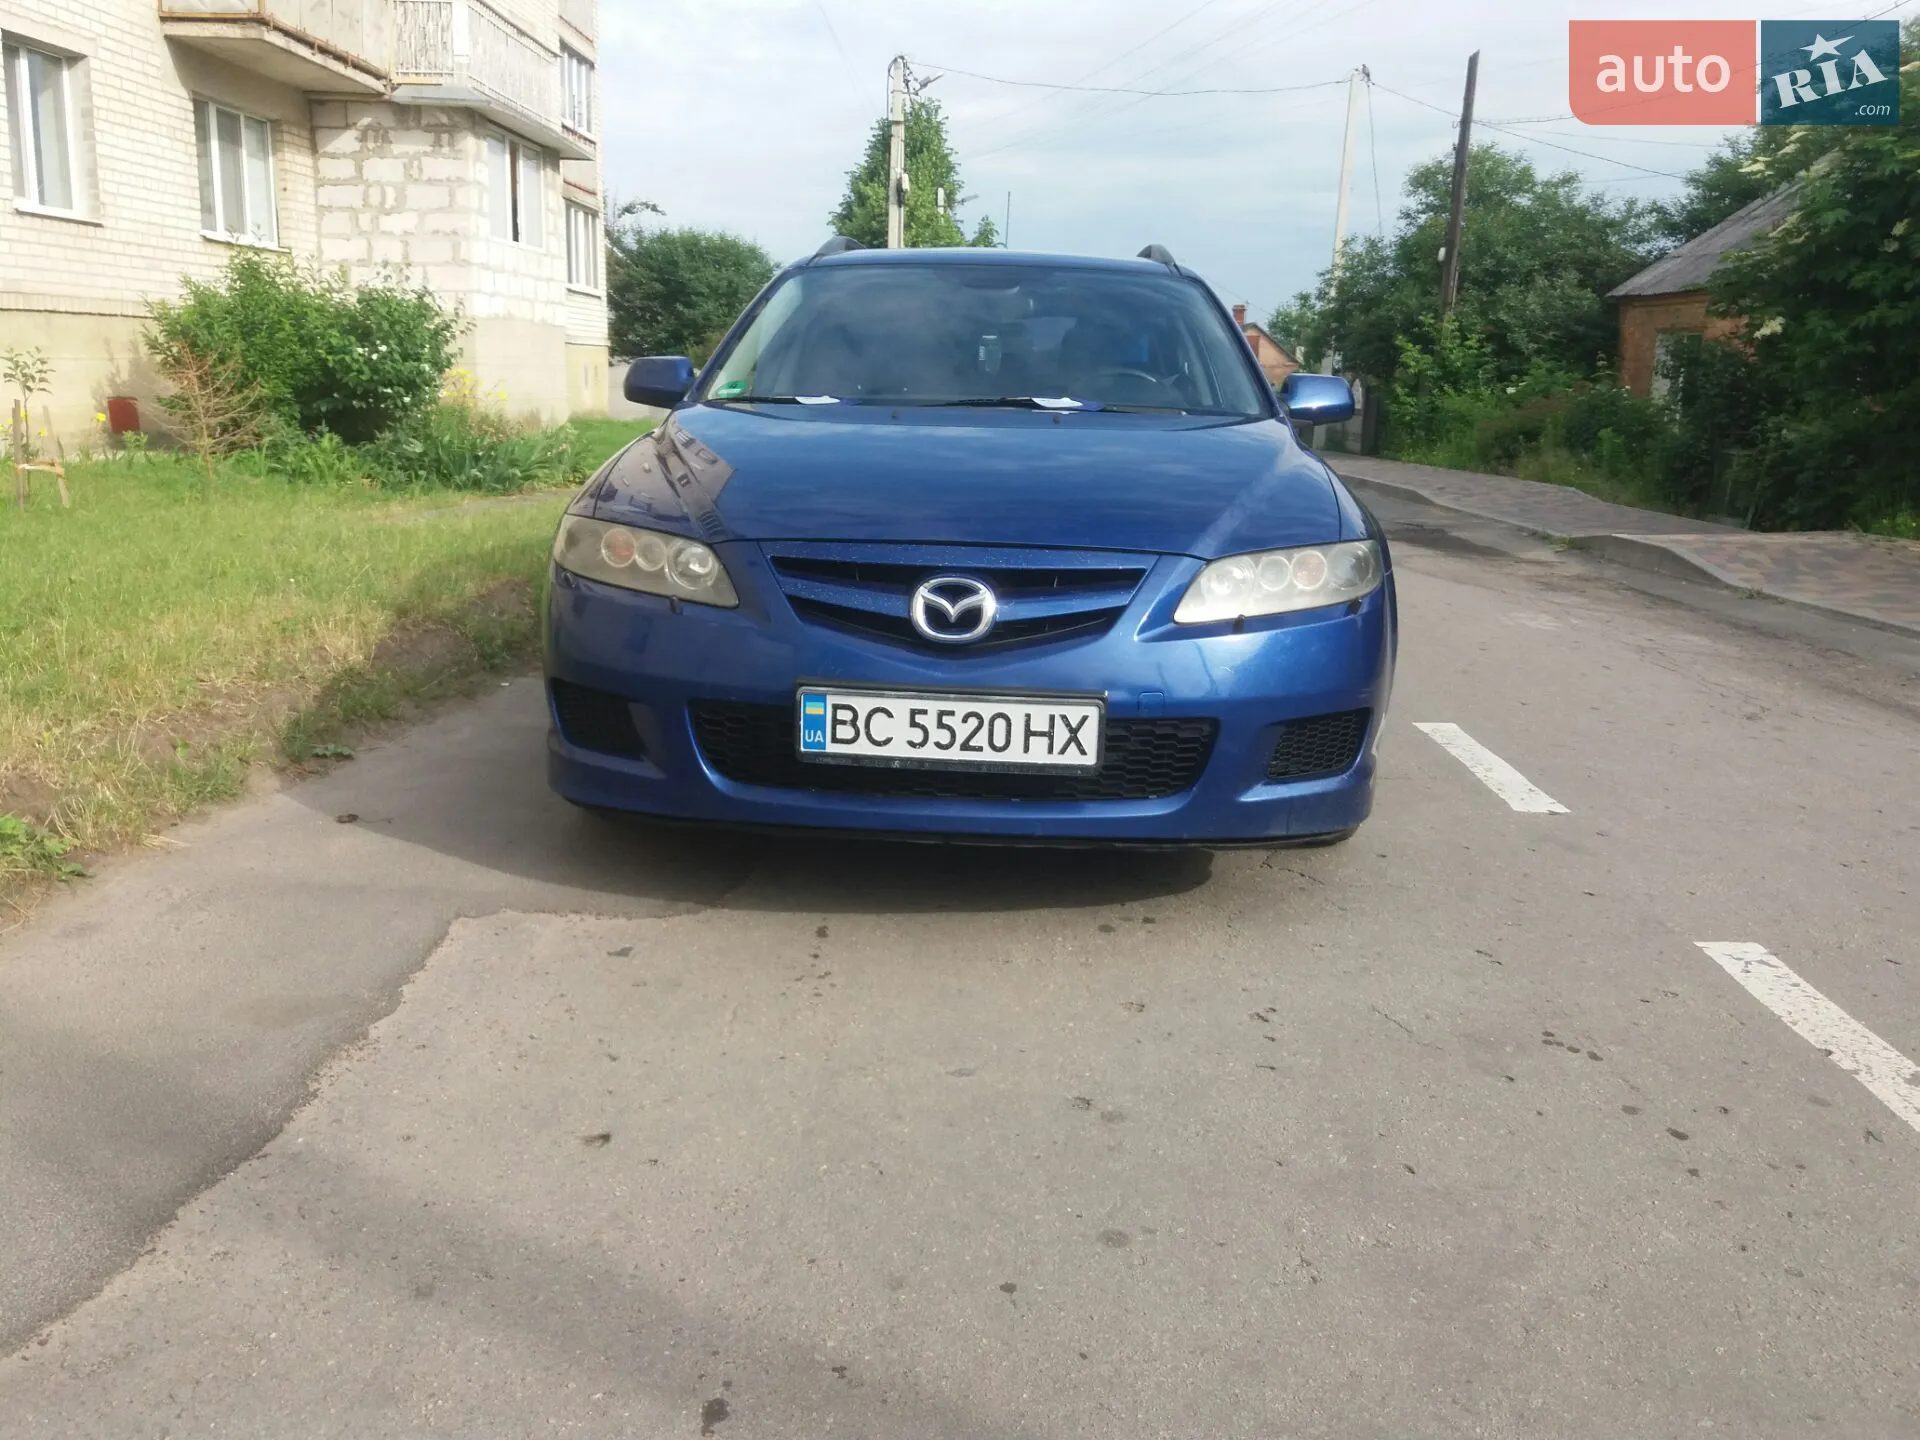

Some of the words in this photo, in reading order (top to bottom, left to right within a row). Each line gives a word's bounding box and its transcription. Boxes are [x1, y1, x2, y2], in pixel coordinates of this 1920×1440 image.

[805, 730, 824, 743] UA
[830, 703, 894, 747] BC
[906, 708, 1012, 753] 5520
[1023, 713, 1090, 756] HX
